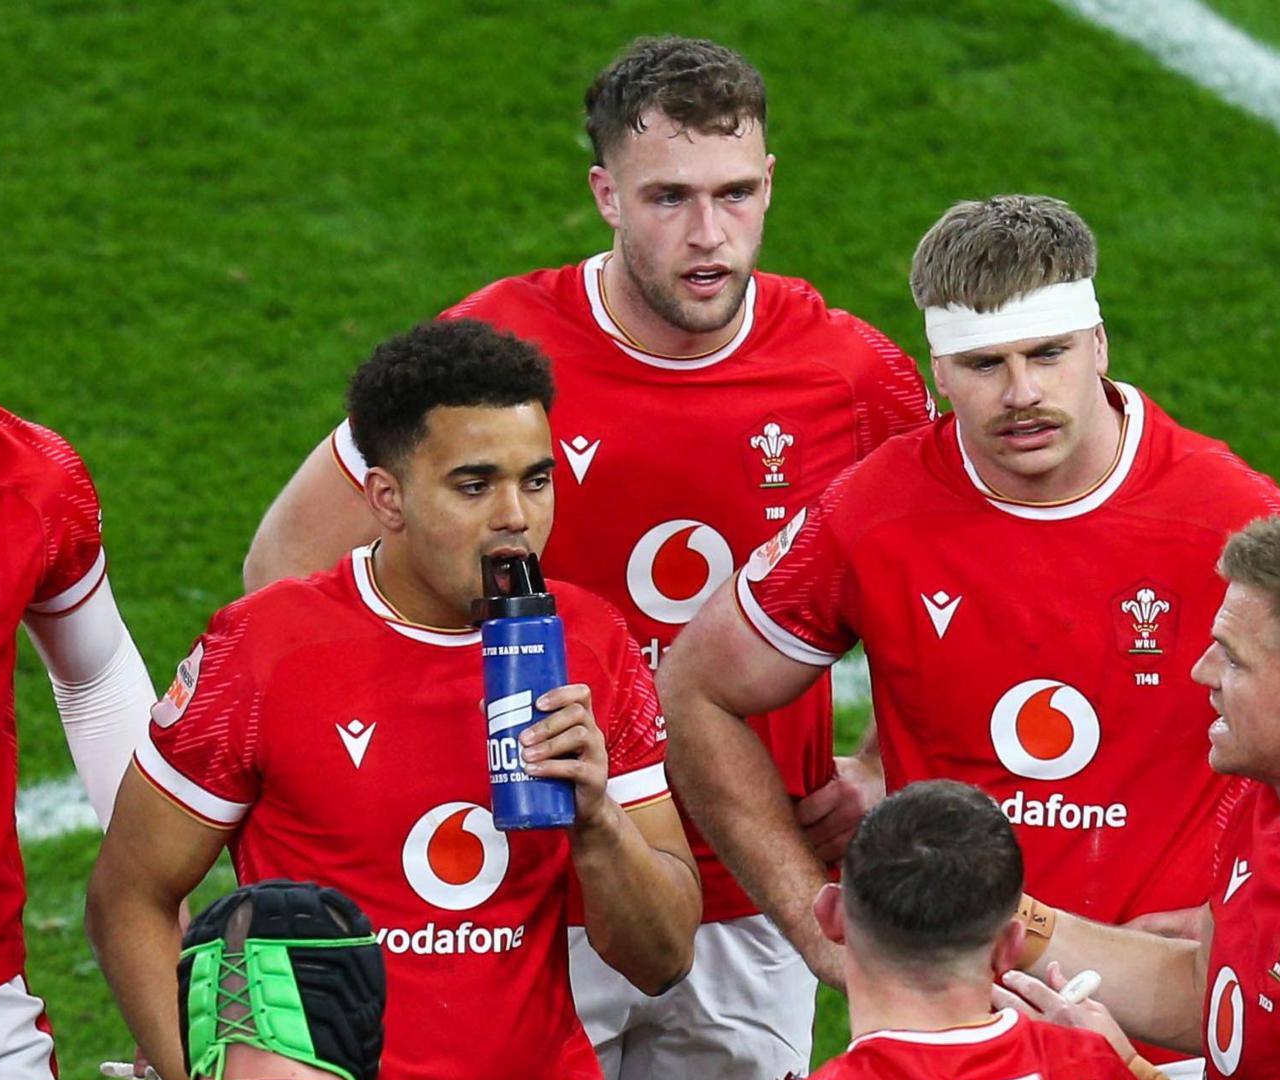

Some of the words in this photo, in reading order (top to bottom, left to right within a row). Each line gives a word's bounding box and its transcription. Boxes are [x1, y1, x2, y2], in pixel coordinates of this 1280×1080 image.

[498, 645, 520, 656] HARD
[521, 644, 545, 655] WORK
[1134, 639, 1156, 649] WRU
[1000, 791, 1127, 829] dafone
